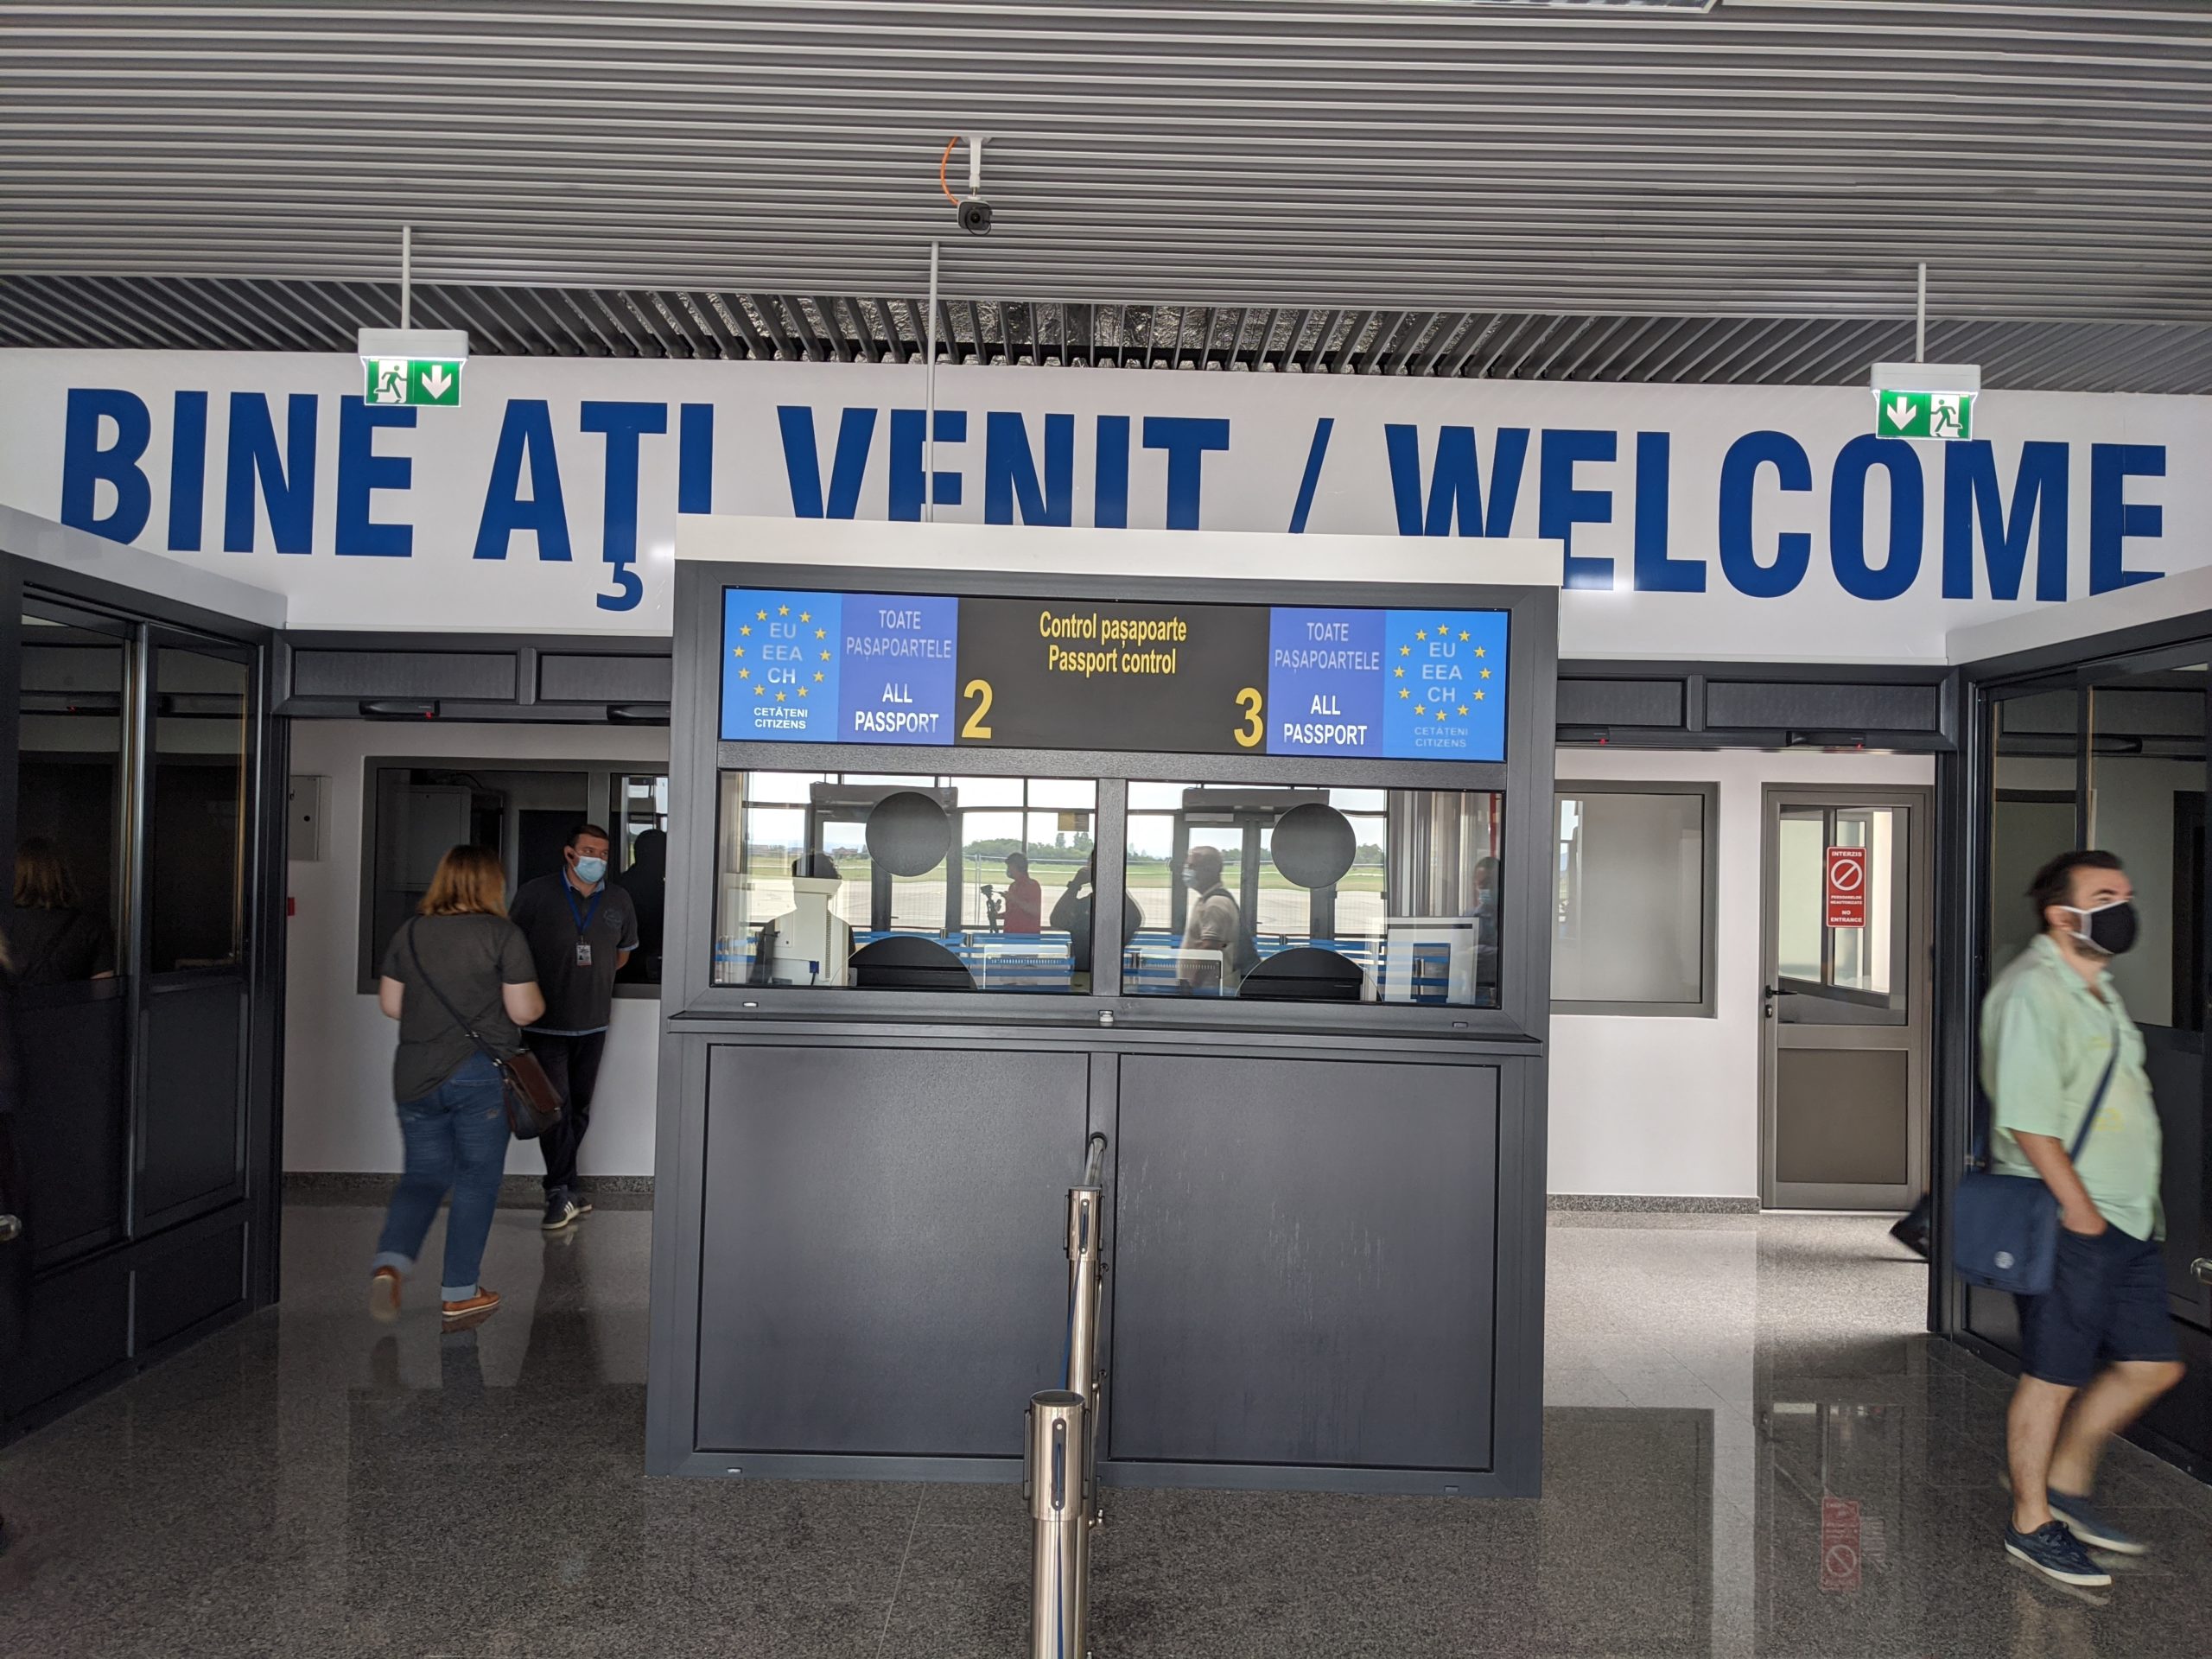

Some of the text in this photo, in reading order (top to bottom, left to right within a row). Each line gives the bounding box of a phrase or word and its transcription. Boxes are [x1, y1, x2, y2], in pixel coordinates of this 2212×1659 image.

[61, 388, 417, 557] BINE
[776, 405, 1230, 531] VENIT
[1384, 423, 2166, 601] WELCOME
[879, 609, 921, 630] TOATE
[1039, 611, 1096, 639] Control
[770, 622, 797, 639] EU
[1306, 622, 1349, 642] TOATE
[762, 645, 803, 661] EEA
[1429, 642, 1455, 658] EU
[1049, 645, 1176, 678] Passport control
[767, 667, 796, 684] CH
[1422, 664, 1462, 680] EEA
[882, 683, 913, 703] ALL
[1427, 687, 1455, 702] CH
[961, 679, 994, 739] 2
[1310, 695, 1341, 715] ALL
[754, 719, 806, 729] CITIZENS
[855, 711, 939, 734] PASSPORT
[1233, 687, 1263, 747] 3
[1284, 723, 1367, 746] PASSPORT
[1415, 739, 1466, 747] CITIZENS
